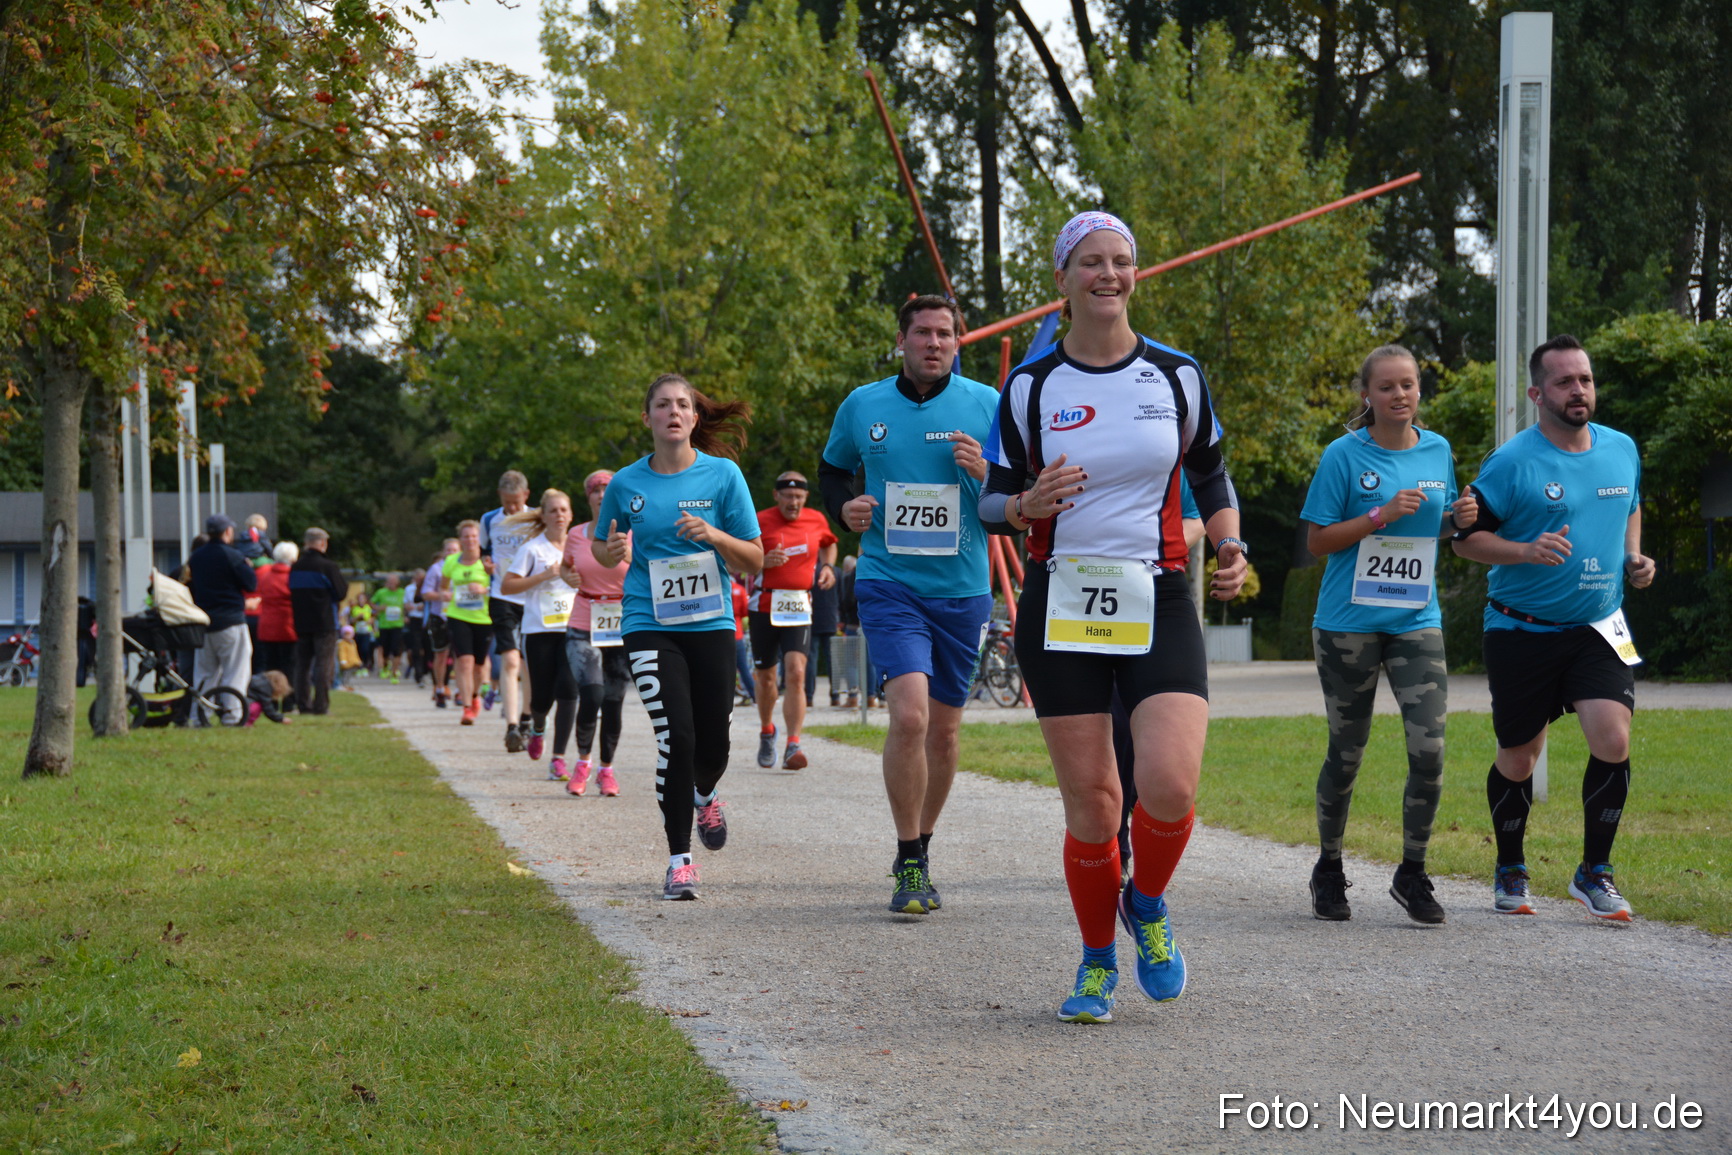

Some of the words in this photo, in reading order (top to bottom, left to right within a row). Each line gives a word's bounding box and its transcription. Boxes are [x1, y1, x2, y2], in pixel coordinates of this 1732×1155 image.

[1052, 409, 1082, 423] tkn
[925, 432, 954, 440] BOC
[1417, 480, 1445, 489] BOCK
[1597, 487, 1630, 497] BOCK
[678, 501, 712, 509] BOCK
[896, 505, 948, 527] 2756
[1087, 566, 1123, 574] BOCK
[1367, 556, 1422, 580] 2440
[1583, 557, 1601, 572] 18.
[662, 573, 709, 598] 2171
[1377, 585, 1407, 595] Antonia
[554, 600, 568, 611] 39
[680, 602, 700, 611] Sonja
[1082, 587, 1118, 616] 75
[597, 616, 620, 629] 217
[1085, 626, 1112, 637] Hana
